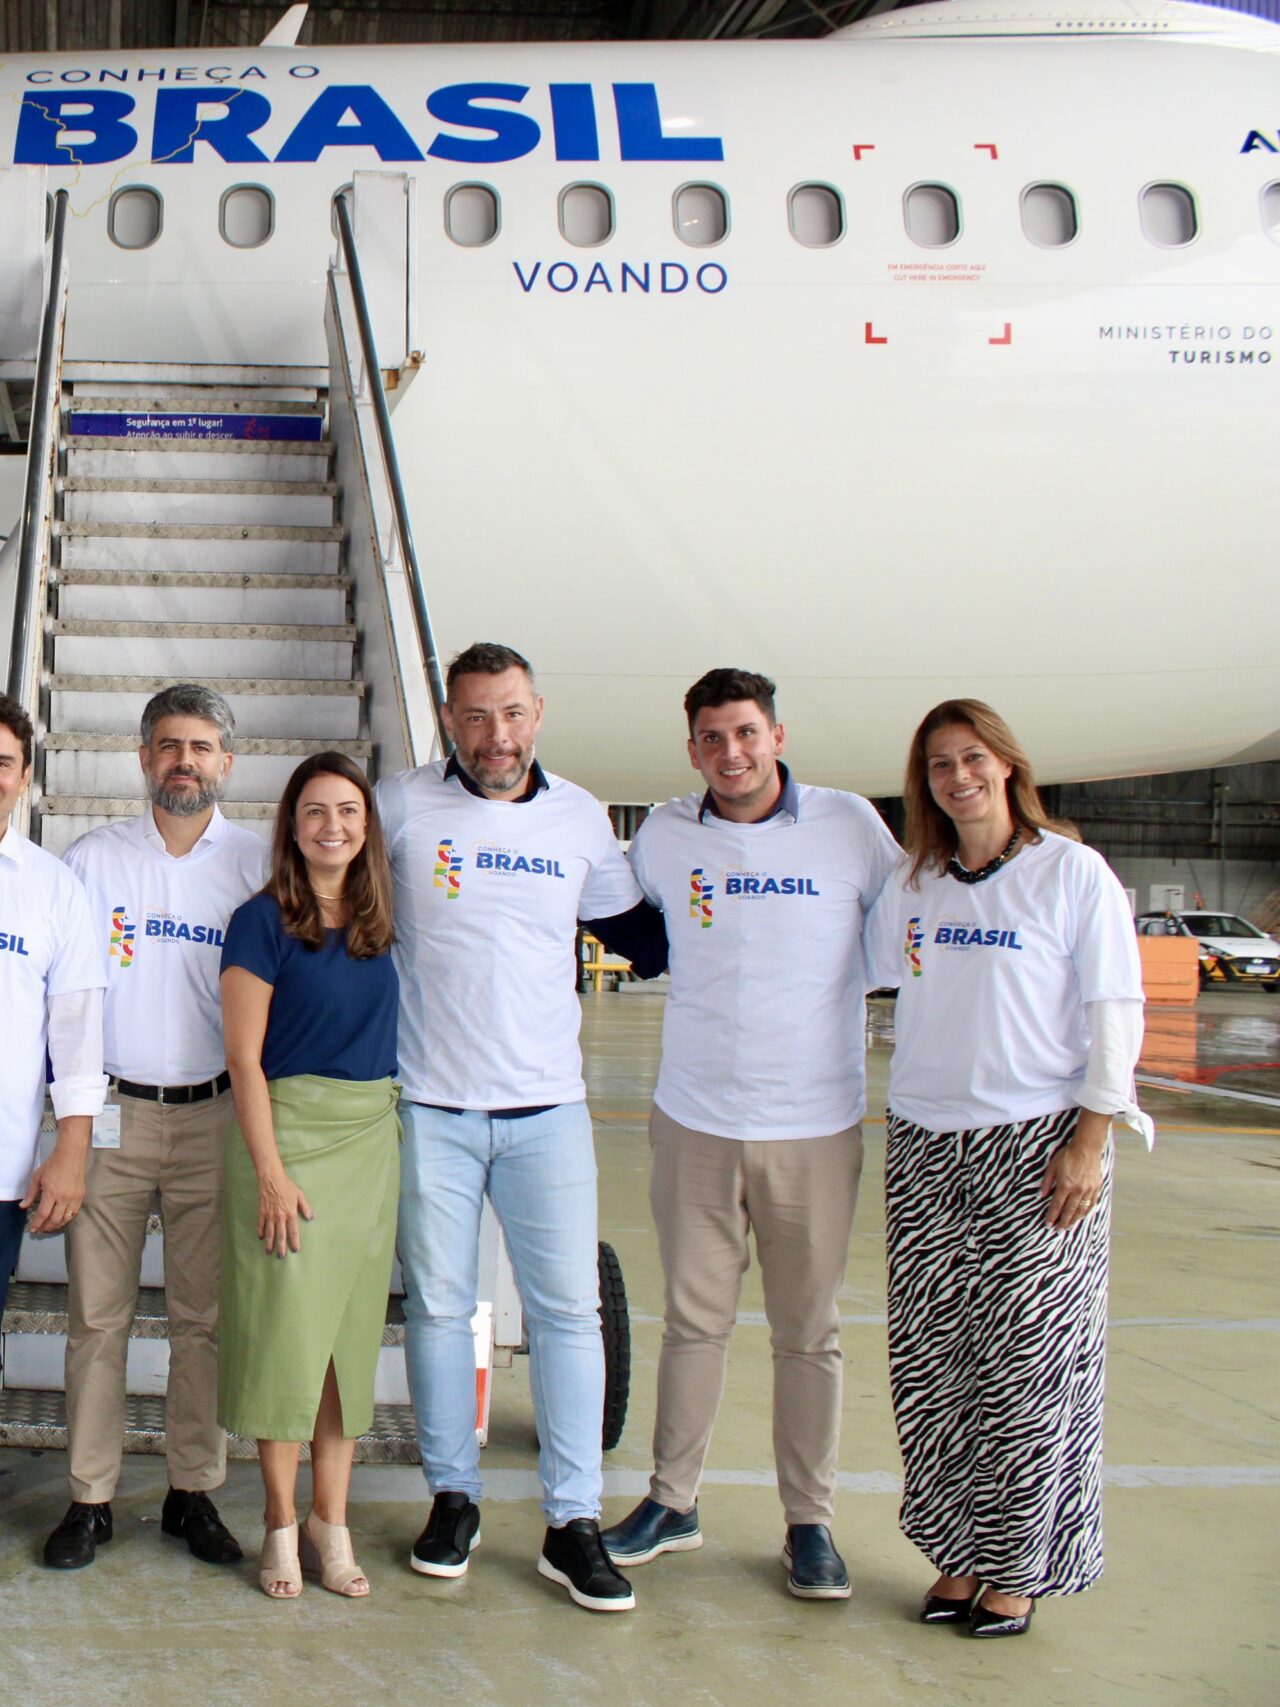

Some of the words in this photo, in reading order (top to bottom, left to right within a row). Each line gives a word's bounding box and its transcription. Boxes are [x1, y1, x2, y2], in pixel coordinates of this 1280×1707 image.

[26, 66, 268, 84] CONHEÇA
[289, 65, 320, 79] O
[13, 83, 724, 165] BRASIL
[1239, 129, 1280, 154] A
[512, 261, 729, 294] VOANDO
[1099, 323, 1231, 340] MINISTÉRIO
[1243, 326, 1273, 340] DO
[1169, 351, 1272, 364] TURISMO
[126, 417, 170, 429] Segurança
[199, 417, 223, 429] lugar!
[476, 852, 565, 879] BRASIL
[726, 877, 820, 896] BRASIL
[145, 919, 225, 948] BRASIL
[934, 927, 1023, 950] BRASIL
